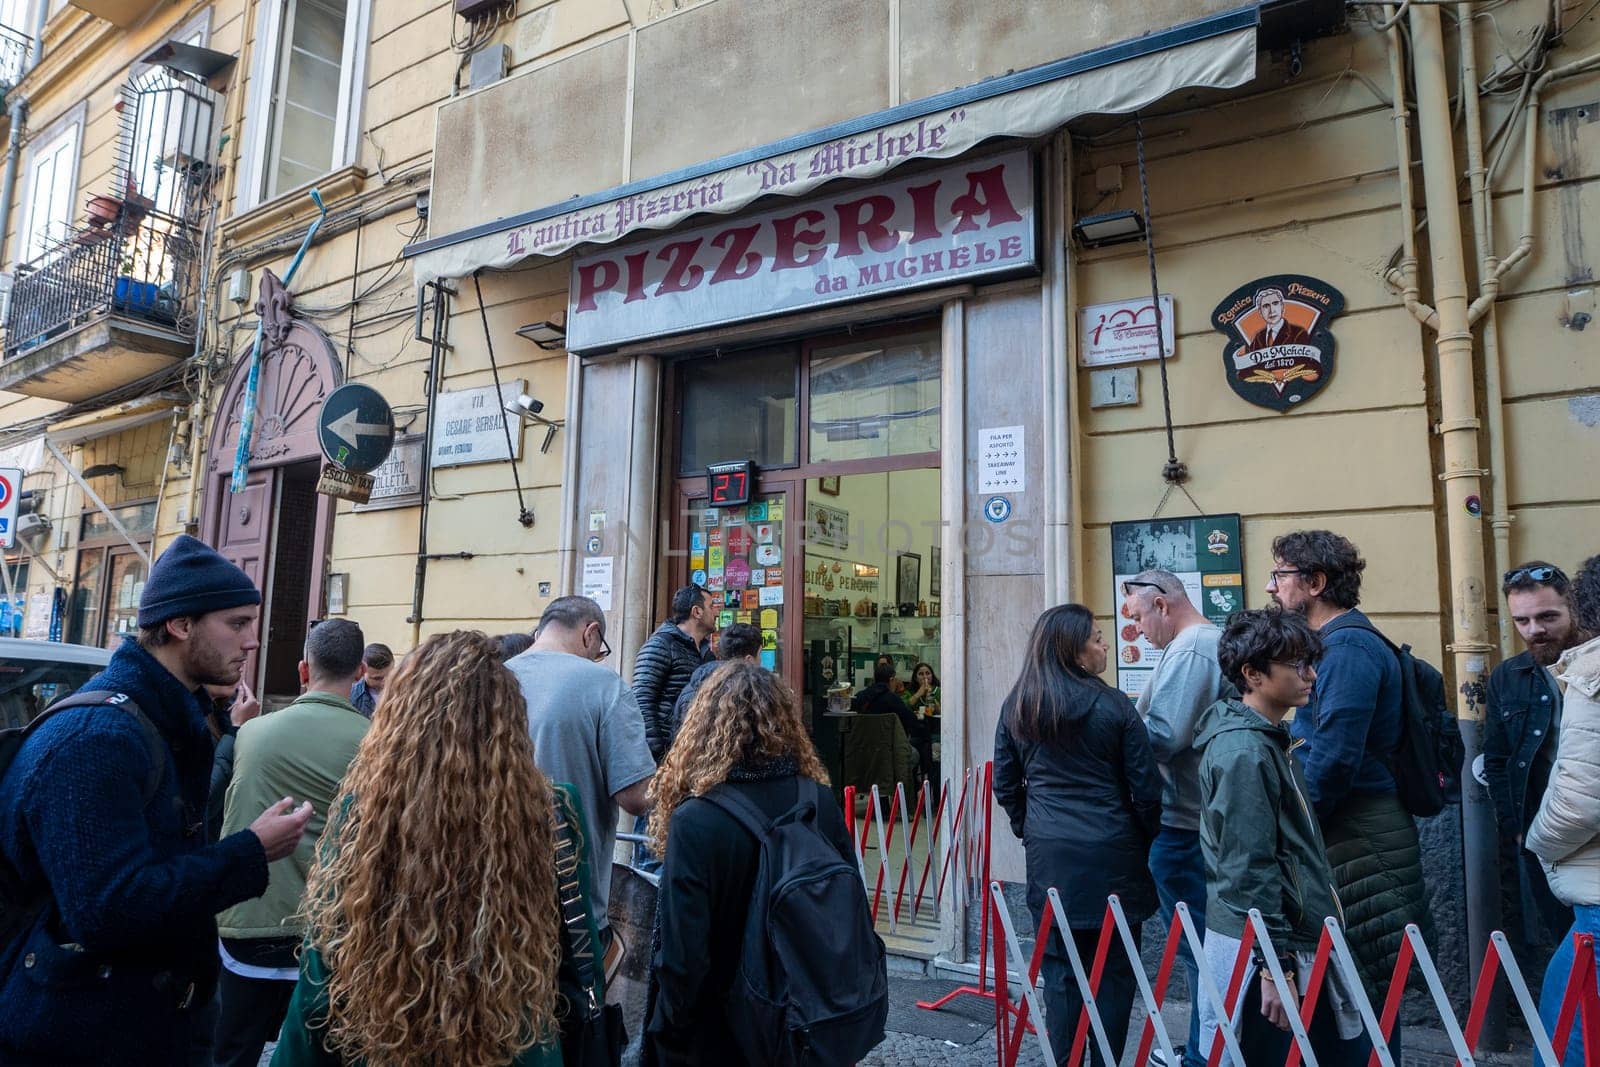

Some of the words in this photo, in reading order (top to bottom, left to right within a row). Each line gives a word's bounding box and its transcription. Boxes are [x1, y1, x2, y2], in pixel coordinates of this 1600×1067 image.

[614, 180, 725, 238] Pizzeria
[575, 163, 1023, 314] PIZZERIA
[814, 274, 848, 295] da
[857, 236, 1023, 288] MICHELE
[1287, 282, 1331, 306] Pizzeria
[1249, 350, 1269, 363] Da
[1277, 358, 1295, 367] 1870
[1110, 375, 1116, 398] 1
[472, 395, 484, 408] VIA
[445, 418, 472, 437] CESARE
[475, 412, 507, 433] SERSAL
[375, 473, 410, 489] OLLETTA
[713, 472, 746, 502] 27
